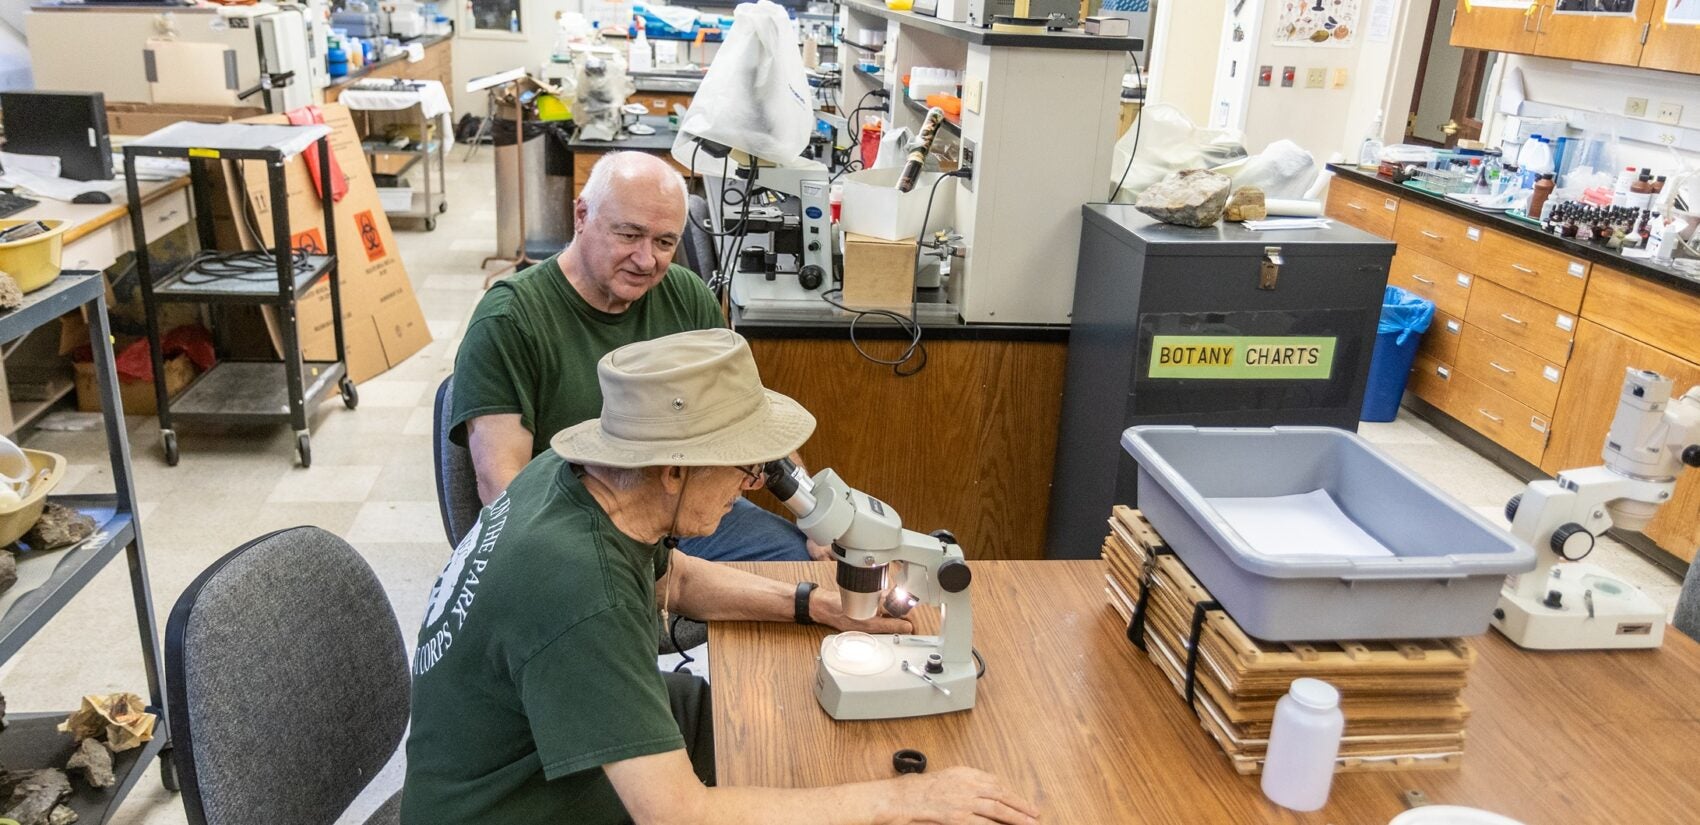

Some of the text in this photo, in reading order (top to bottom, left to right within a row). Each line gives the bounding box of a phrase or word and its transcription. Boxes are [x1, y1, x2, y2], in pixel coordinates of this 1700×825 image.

[1160, 346, 1320, 365] BOTANY CHARTS
[478, 515, 508, 554] THE
[451, 558, 489, 630] PARK
[419, 620, 453, 675] CORPS
